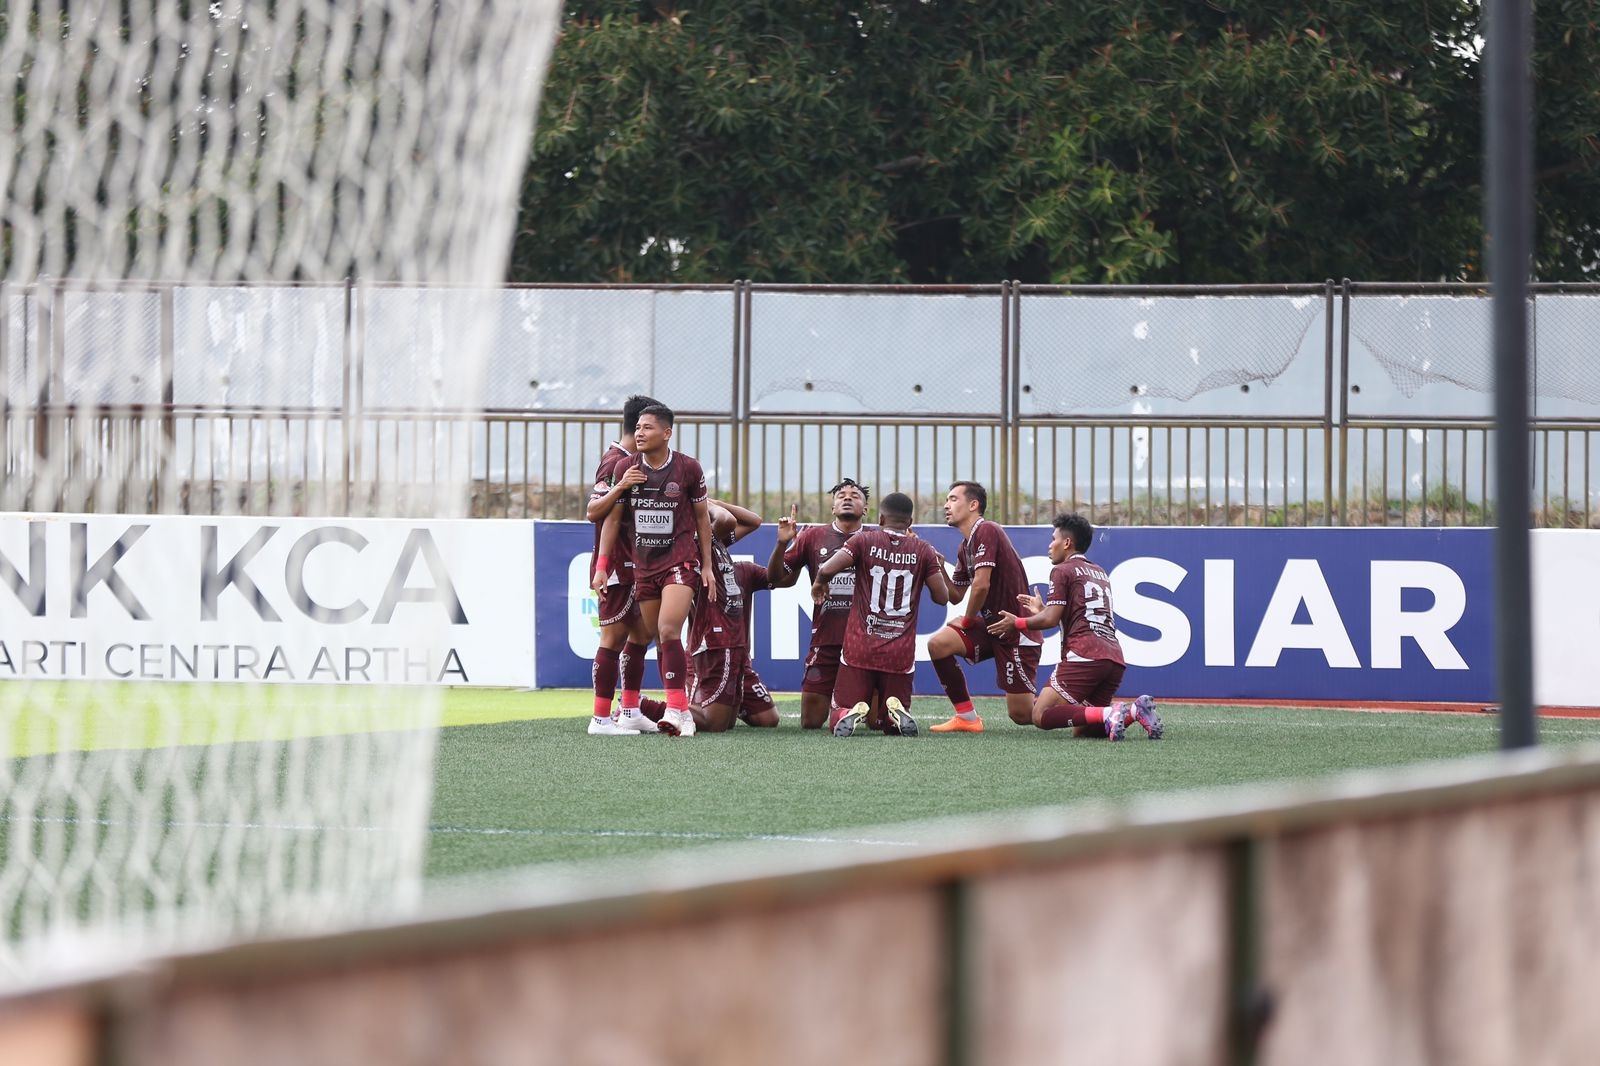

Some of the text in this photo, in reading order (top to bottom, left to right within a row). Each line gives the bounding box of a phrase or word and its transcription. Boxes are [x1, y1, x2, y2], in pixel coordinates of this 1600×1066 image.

[638, 514, 670, 524] SUKUN
[869, 546, 917, 565] PALACIOS
[200, 525, 470, 625] KCA
[829, 576, 856, 585] UKUN
[869, 565, 914, 616] 10
[105, 643, 295, 680] CENTRA
[308, 646, 469, 682] ARTHA
